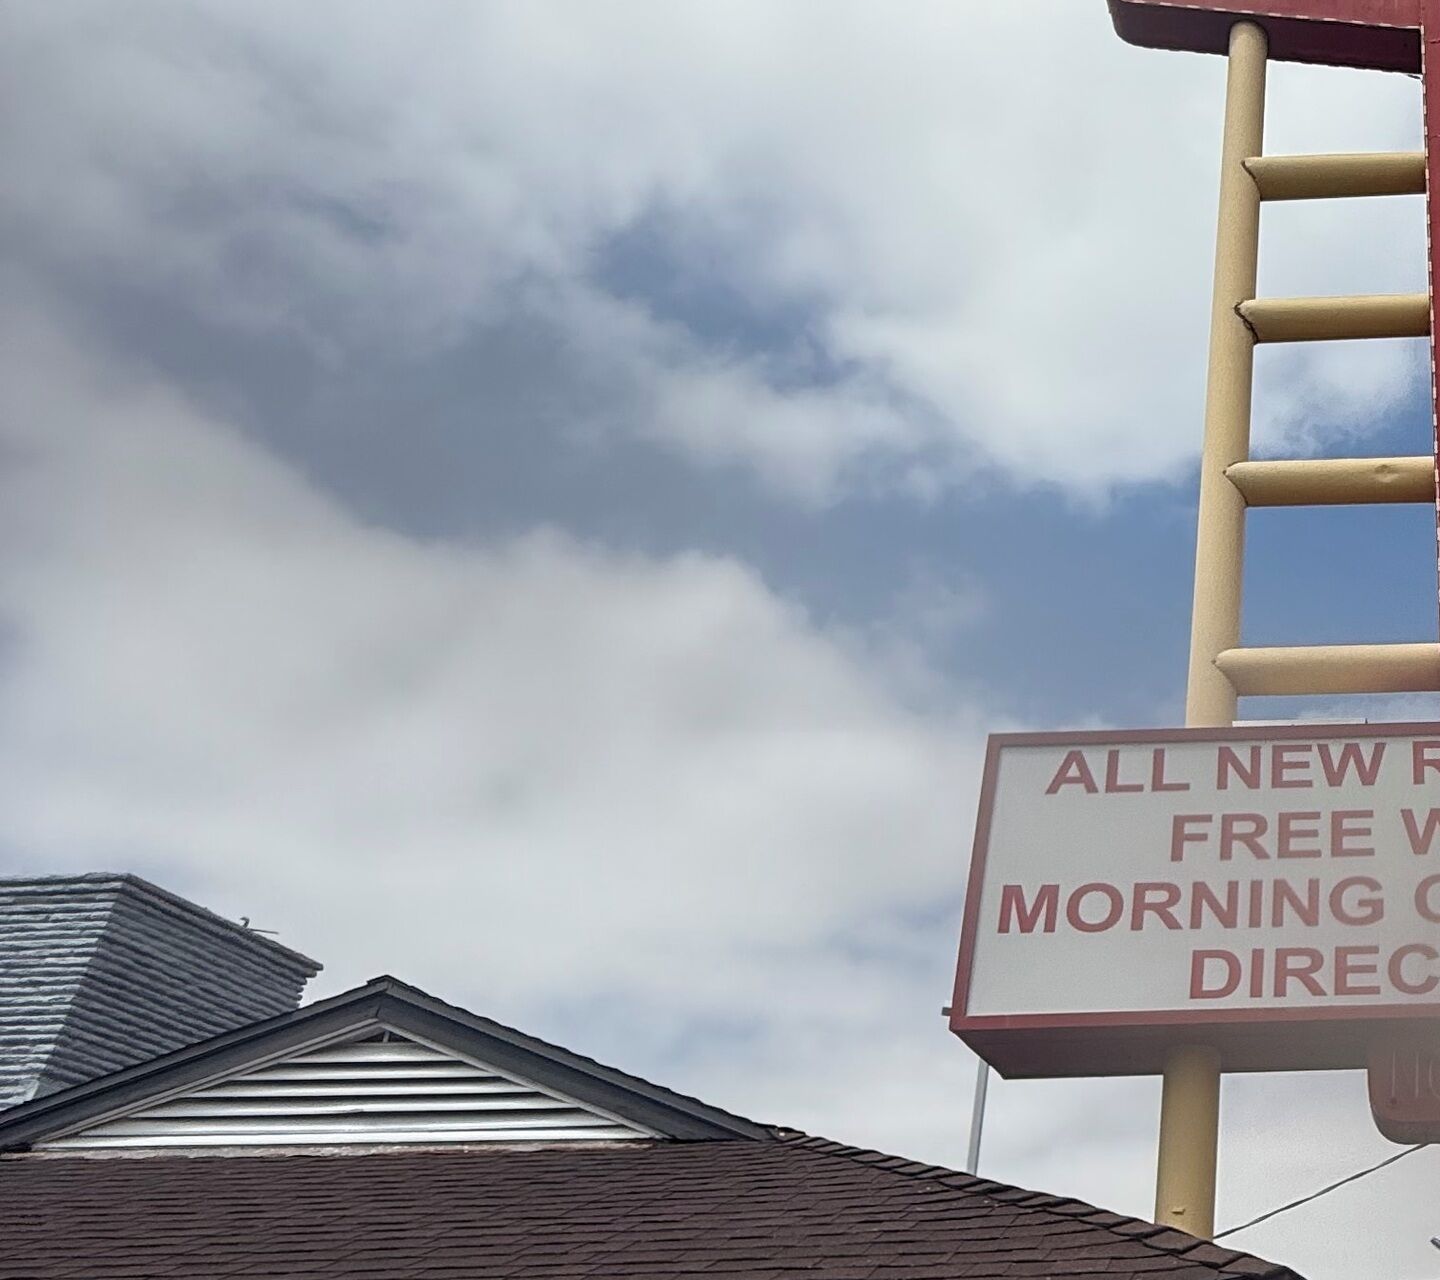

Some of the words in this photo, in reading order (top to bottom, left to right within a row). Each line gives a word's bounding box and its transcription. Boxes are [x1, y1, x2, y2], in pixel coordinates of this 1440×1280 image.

[1045, 747, 1191, 796] ALL
[1216, 741, 1388, 792] NEW
[1170, 809, 1376, 863] FREE
[997, 874, 1386, 935] MORNING
